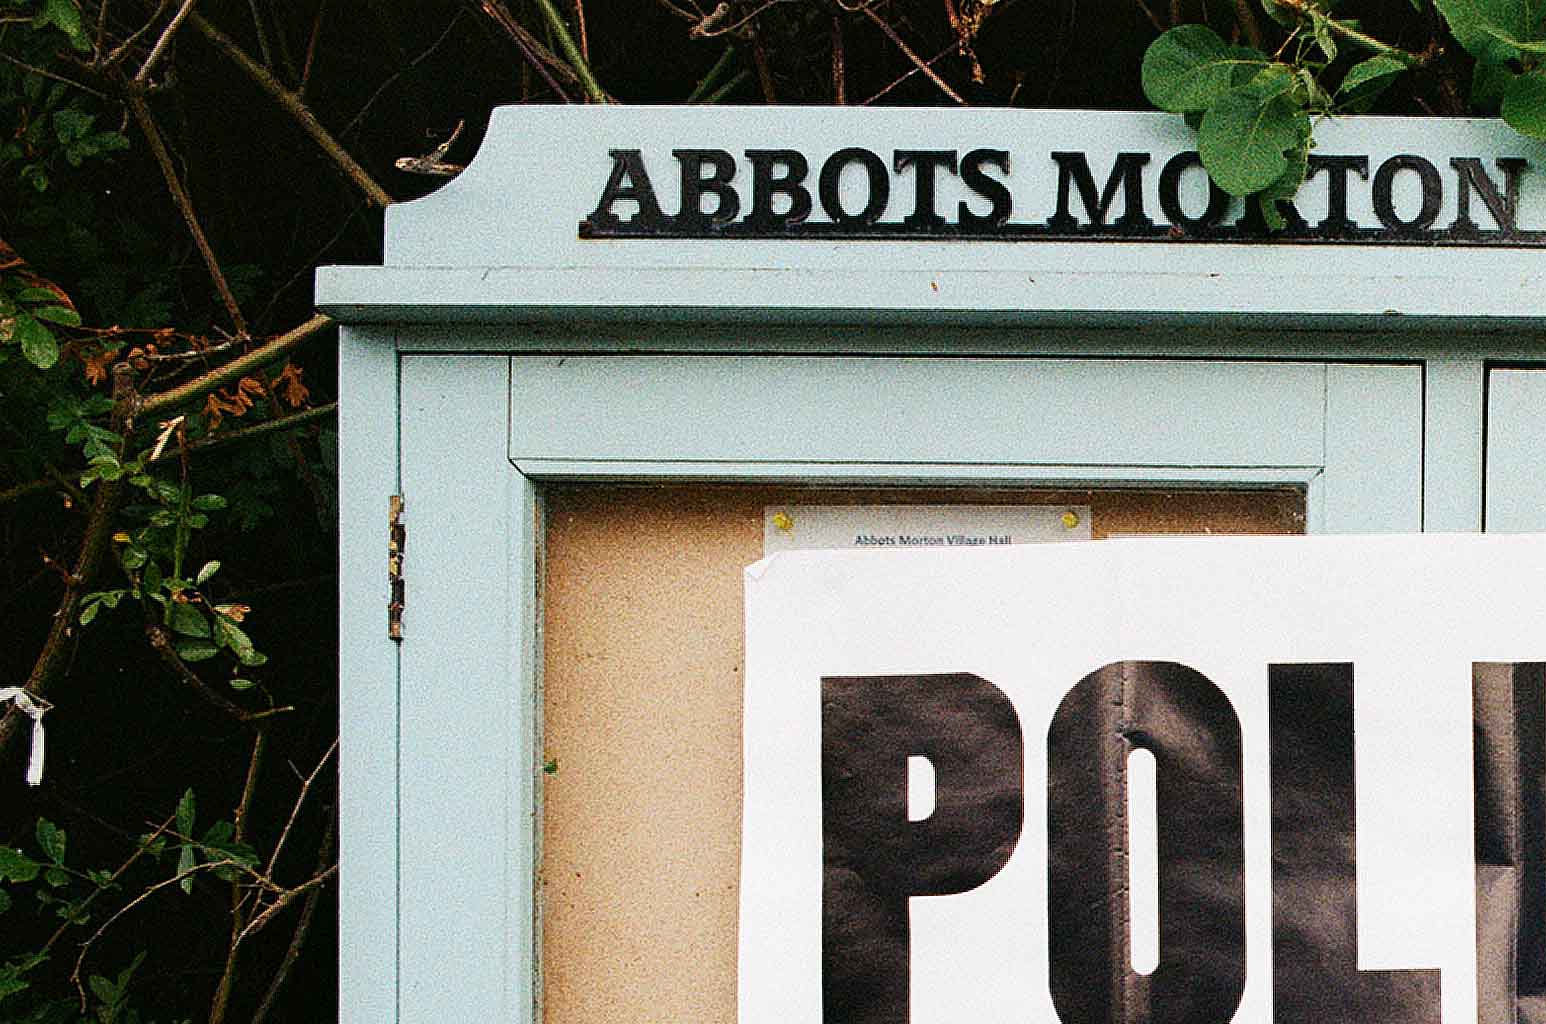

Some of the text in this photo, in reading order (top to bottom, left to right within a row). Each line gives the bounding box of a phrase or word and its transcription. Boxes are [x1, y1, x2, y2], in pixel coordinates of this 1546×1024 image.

[580, 146, 1014, 232] ABBOTS
[855, 535, 1012, 547] Abbots Morton Village Hall
